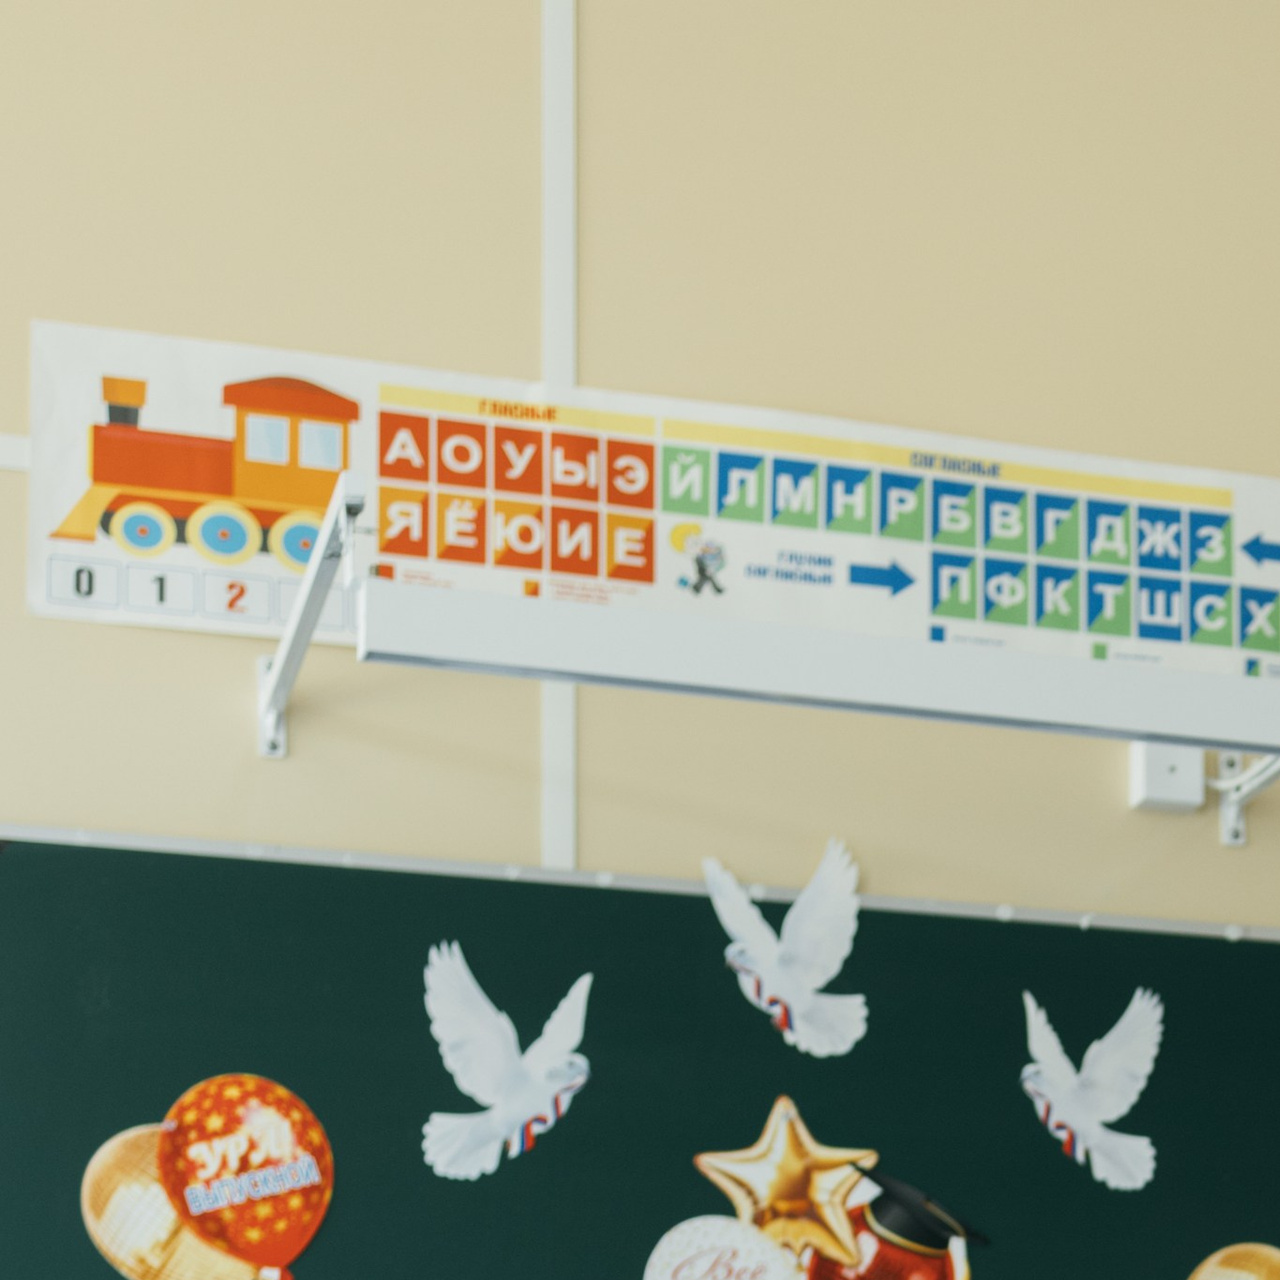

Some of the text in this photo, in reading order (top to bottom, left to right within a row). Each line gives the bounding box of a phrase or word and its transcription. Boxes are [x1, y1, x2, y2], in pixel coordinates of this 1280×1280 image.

[384, 428, 1226, 563] А О У Ы Э Й Л М Н Р Б В Г Д Ж З
[385, 499, 647, 568] Я Ё Ю И Е
[75, 566, 247, 613] 0 1 2
[938, 565, 971, 605] П
[985, 572, 1027, 608] Ф
[1043, 576, 1071, 617] К
[1092, 581, 1125, 621] Т
[1139, 588, 1182, 628] Ш
[1193, 594, 1227, 631] С
[1245, 599, 1276, 638] Х
[185, 1153, 321, 1215] ВЫПУСКНОЙ
